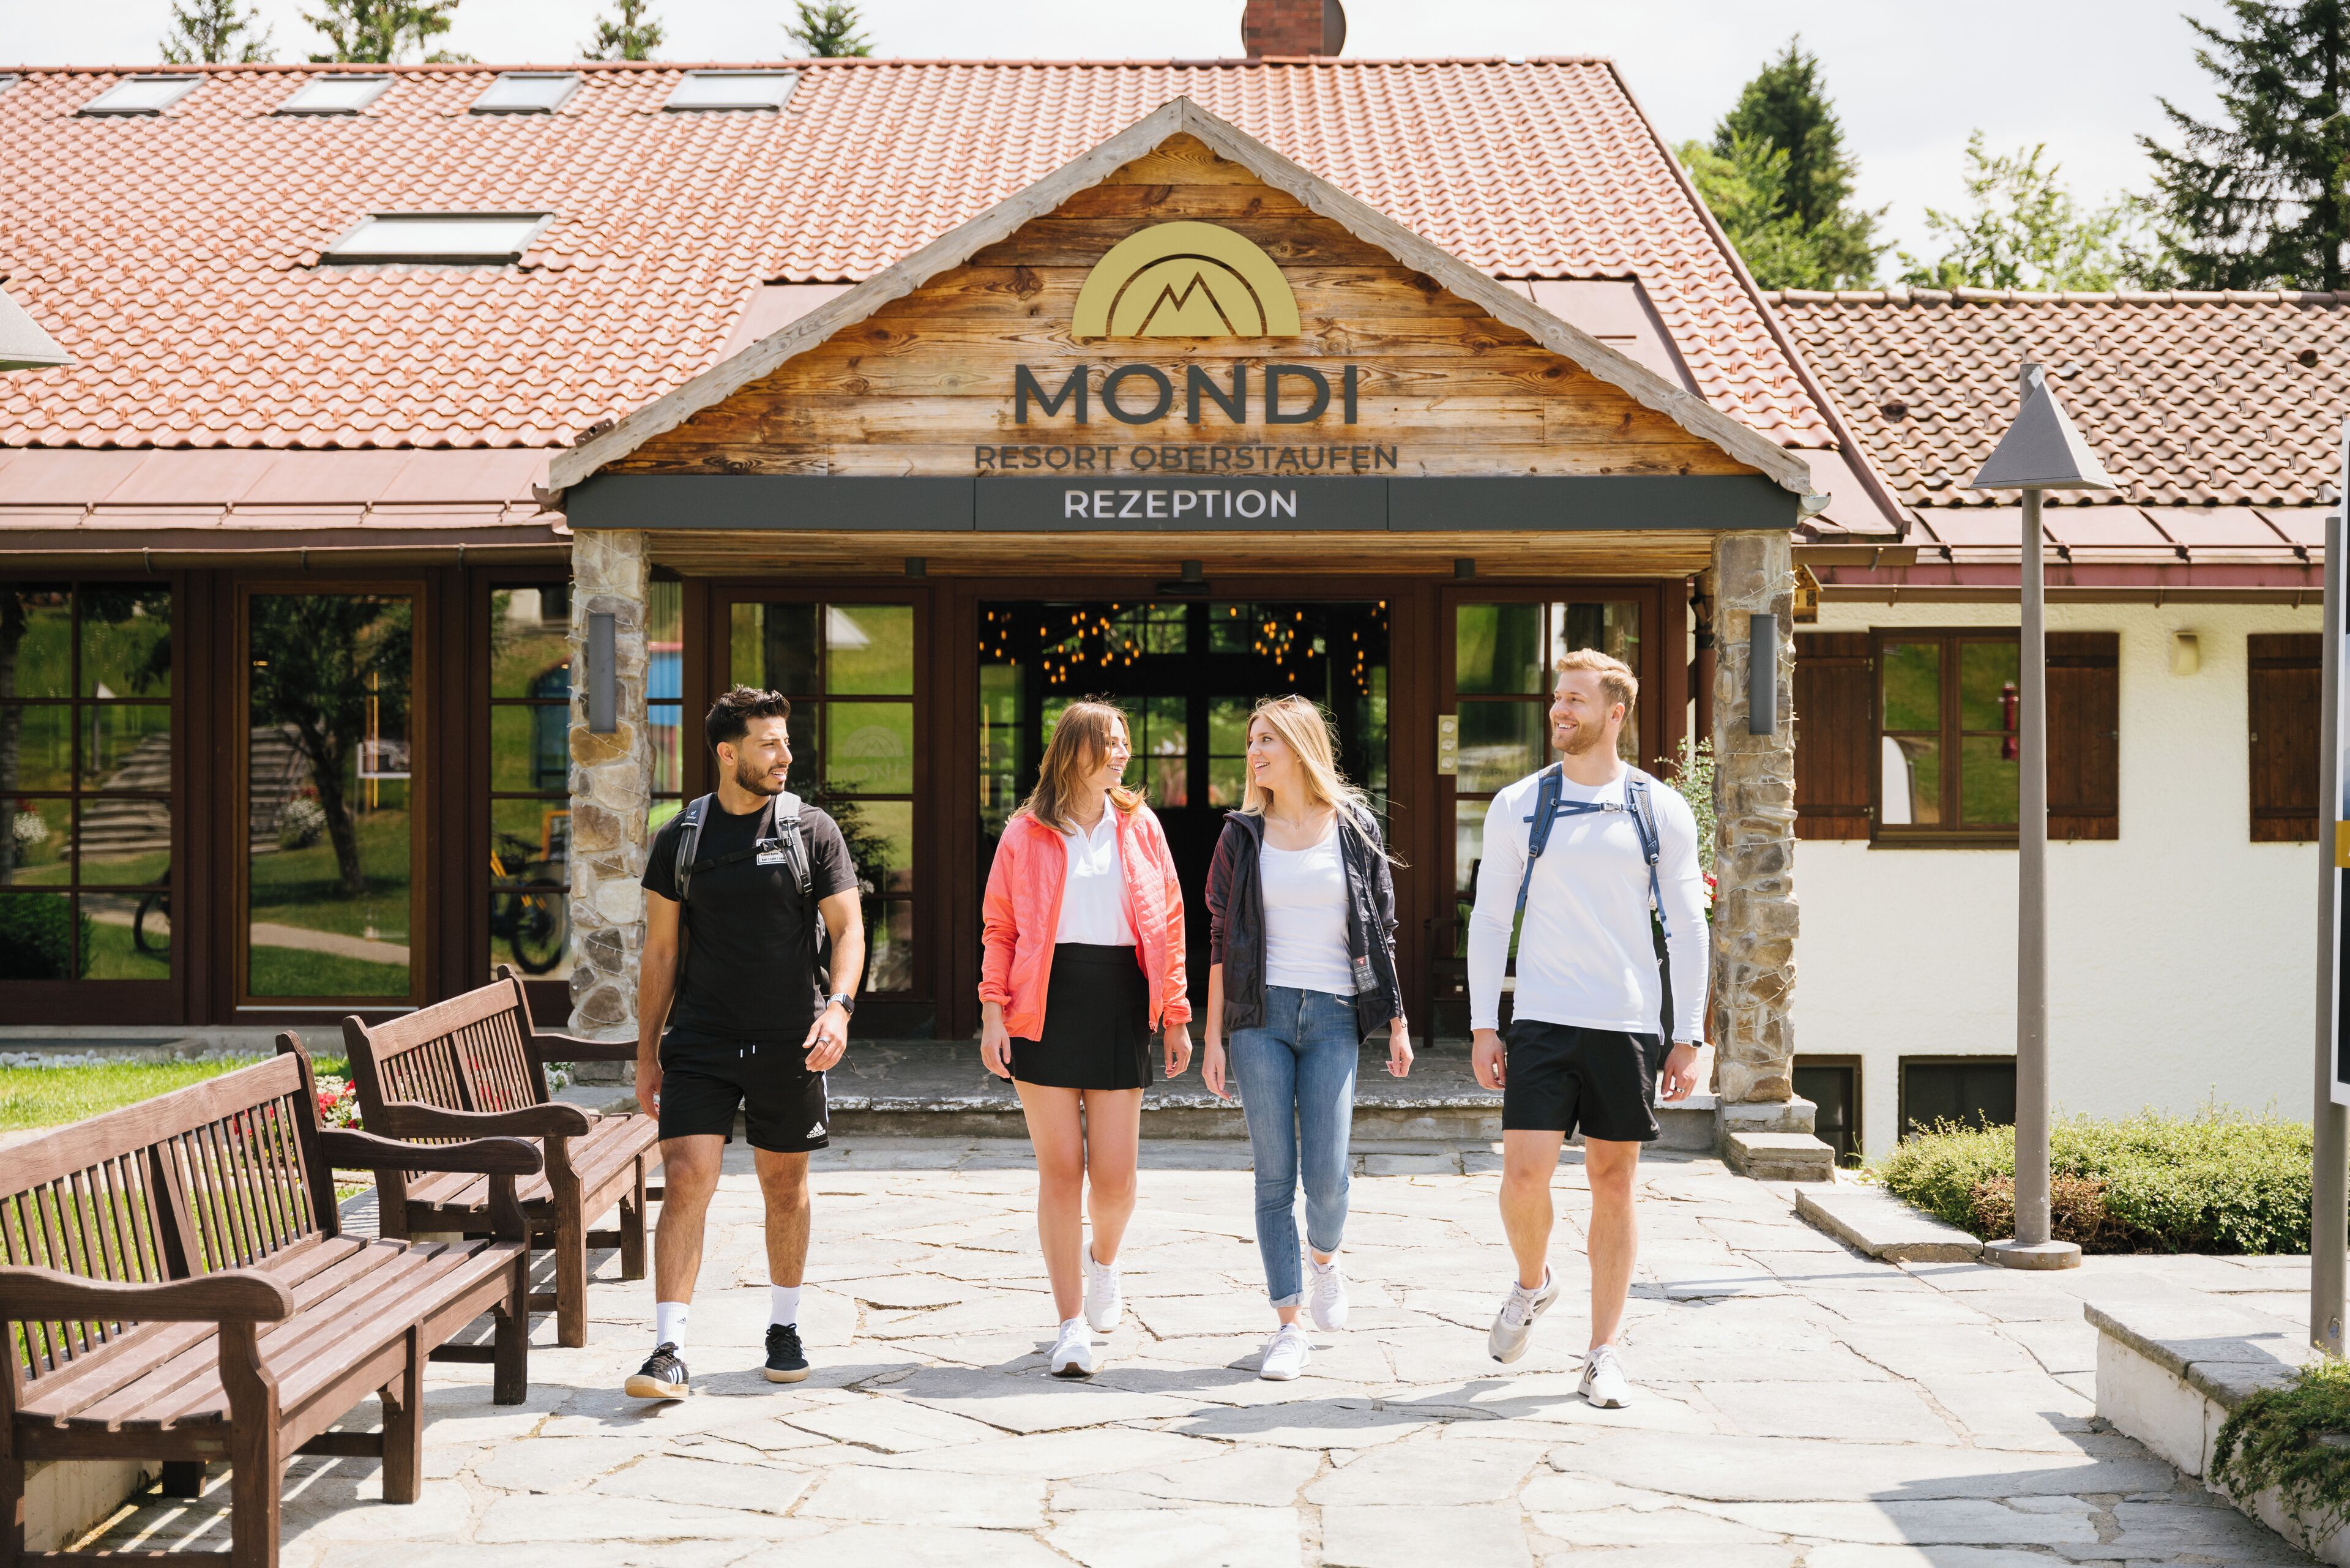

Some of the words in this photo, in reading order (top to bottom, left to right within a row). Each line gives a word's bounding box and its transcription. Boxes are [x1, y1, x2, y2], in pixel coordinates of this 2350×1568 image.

[1015, 364, 1358, 425] MONDI
[974, 446, 1118, 470] RESORT
[1130, 446, 1398, 470] OBERSTAUFEN
[1064, 490, 1297, 518] REZEPTION
[806, 1129, 826, 1138] adidas
